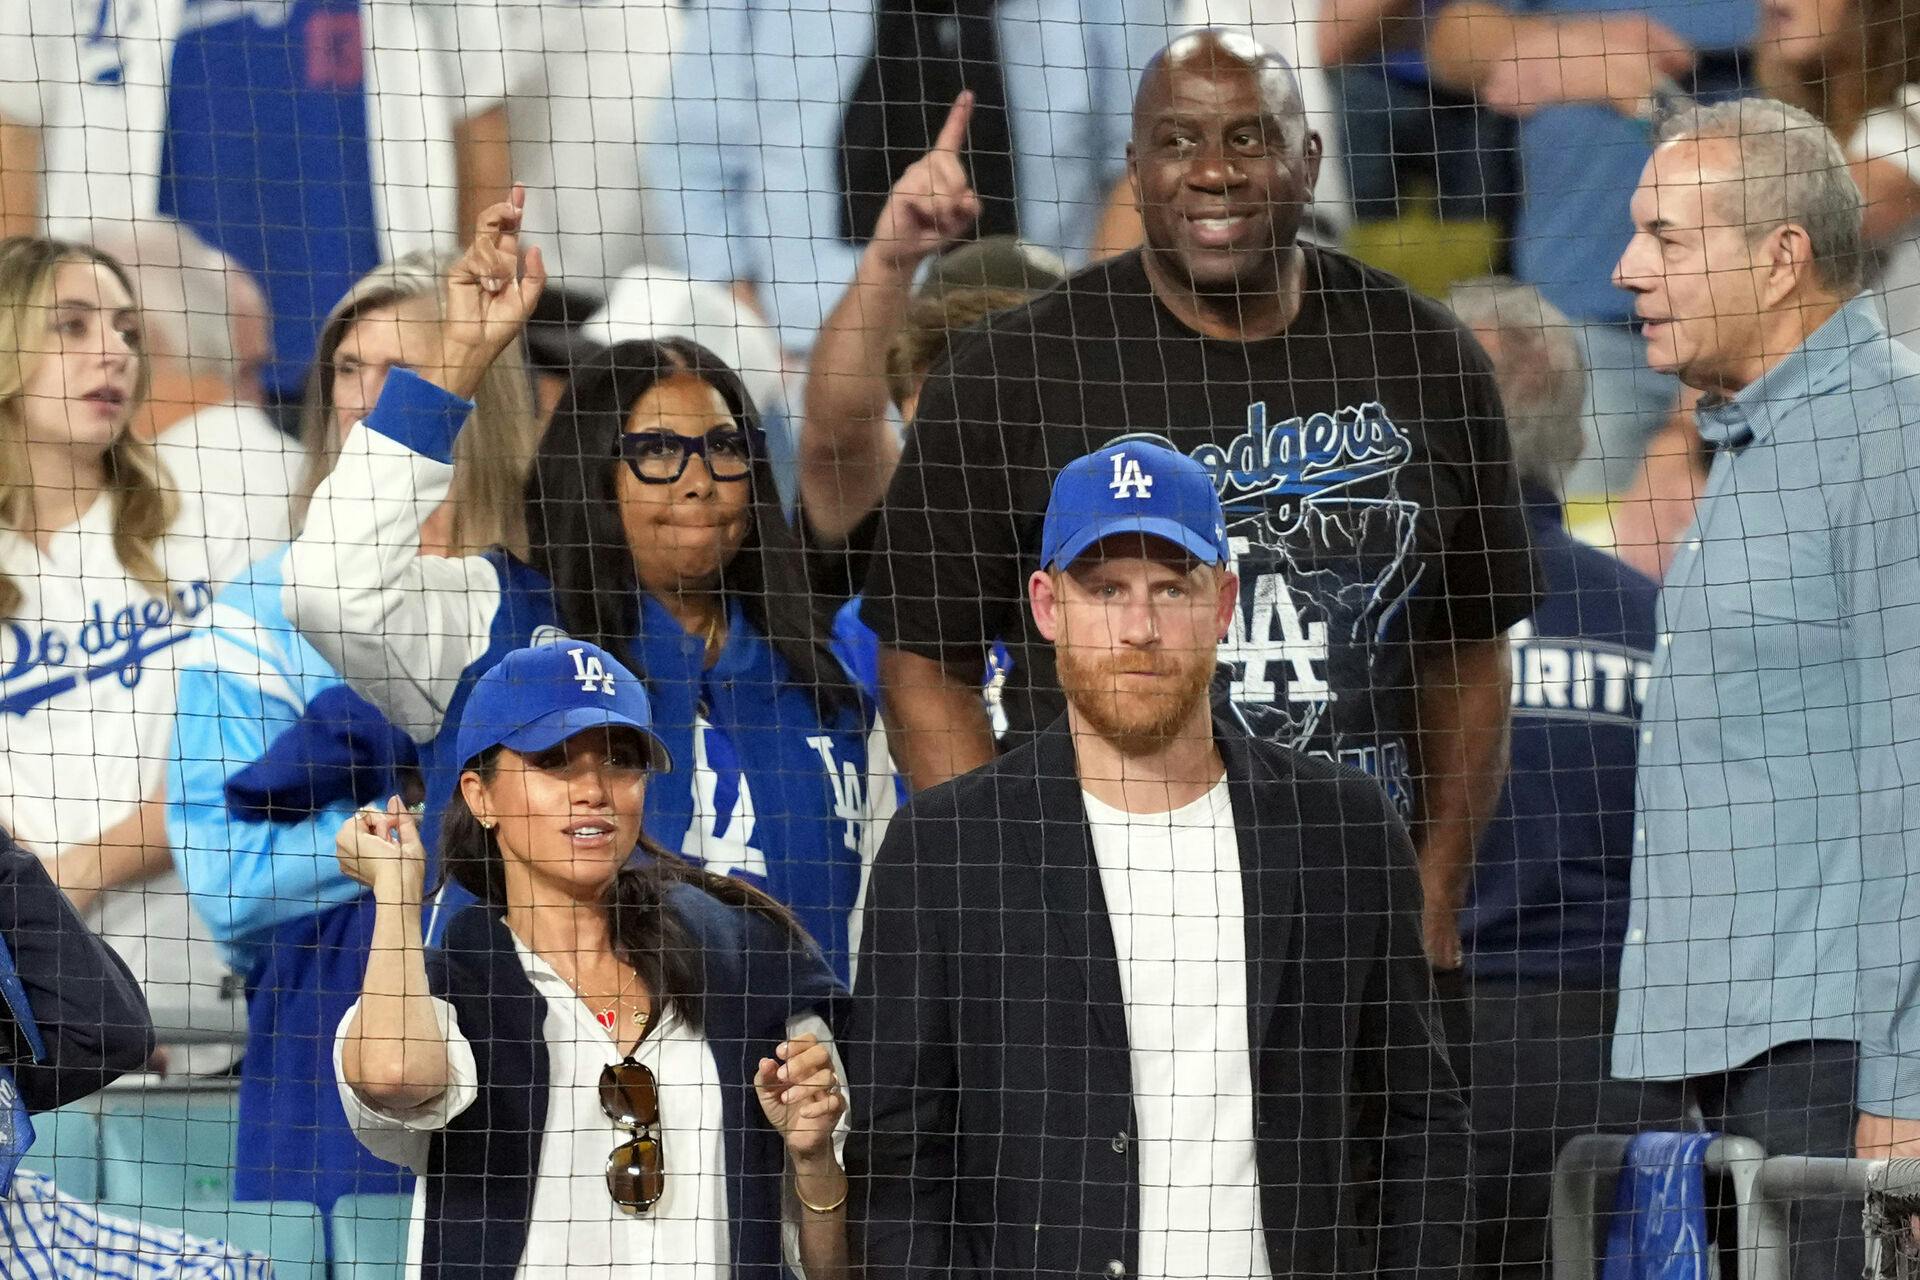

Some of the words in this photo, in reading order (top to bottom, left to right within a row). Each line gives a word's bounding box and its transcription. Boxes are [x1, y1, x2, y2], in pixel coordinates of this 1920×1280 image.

[1098, 400, 1412, 536] odgers
[1109, 452, 1153, 499] LA
[567, 648, 616, 696] LA
